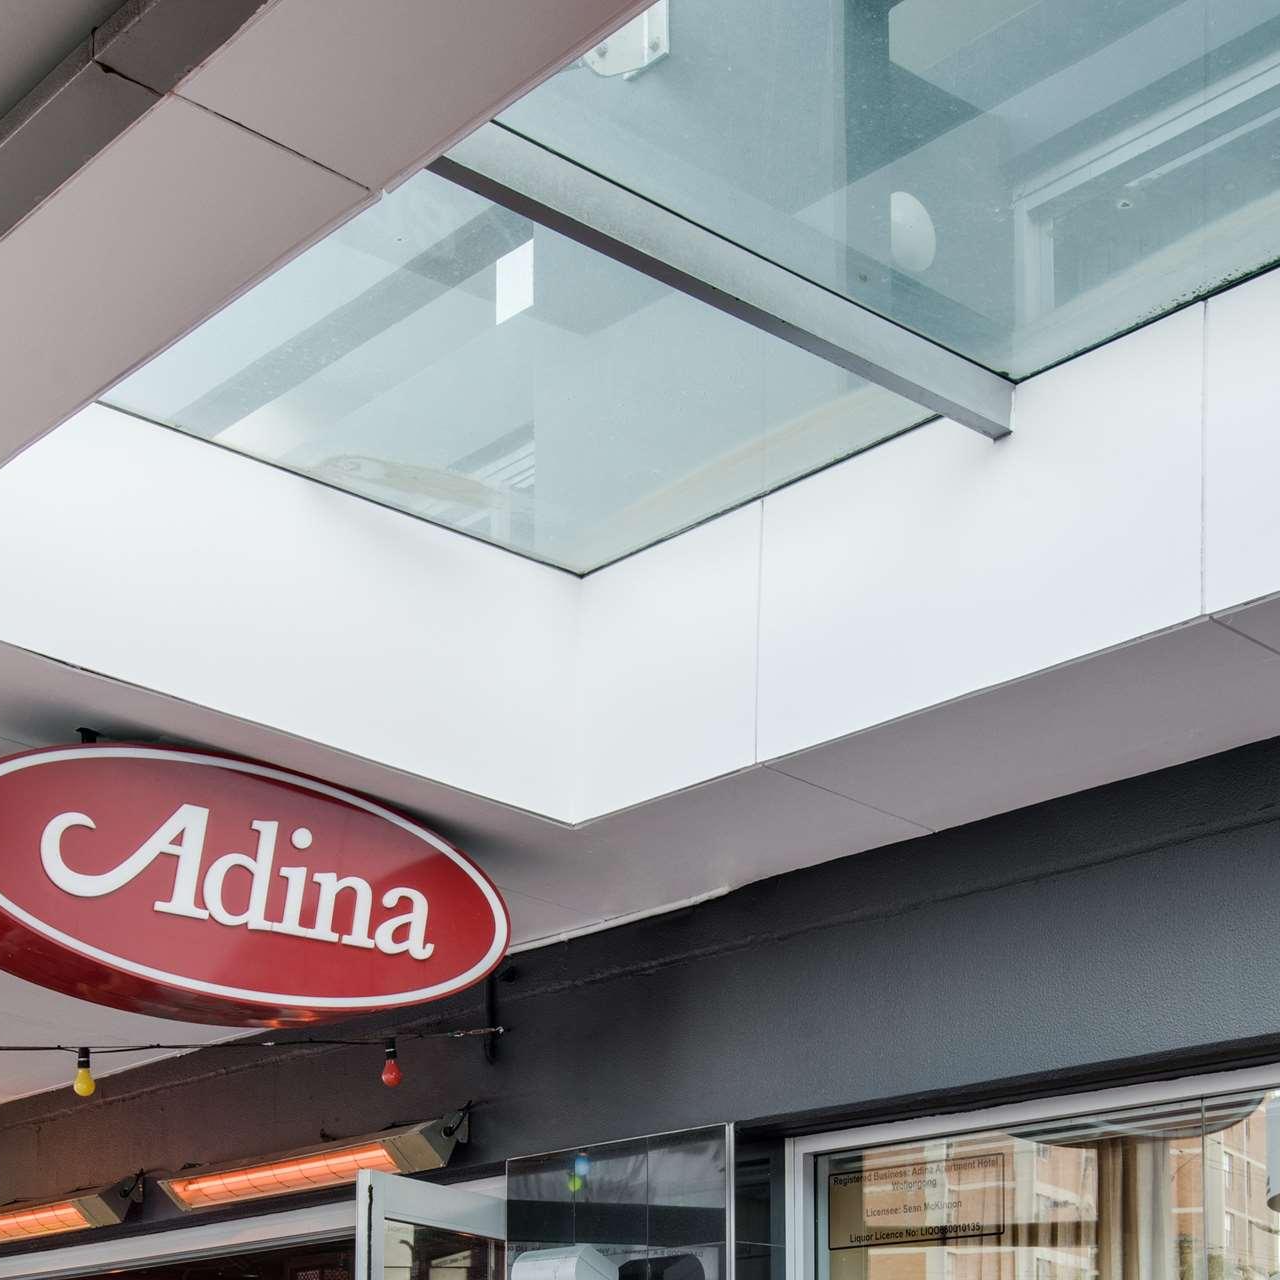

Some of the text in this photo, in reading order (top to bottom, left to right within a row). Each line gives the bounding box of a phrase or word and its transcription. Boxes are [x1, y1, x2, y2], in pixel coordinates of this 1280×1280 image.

[39, 803, 435, 961] Adina
[833, 1158, 999, 1187] Registered Business: Adina Apartment Hotel
[866, 1205, 901, 1217] Licensee:
[903, 1204, 922, 1213] Sean
[849, 1231, 873, 1244] Liquor
[874, 1229, 904, 1241] Licence
